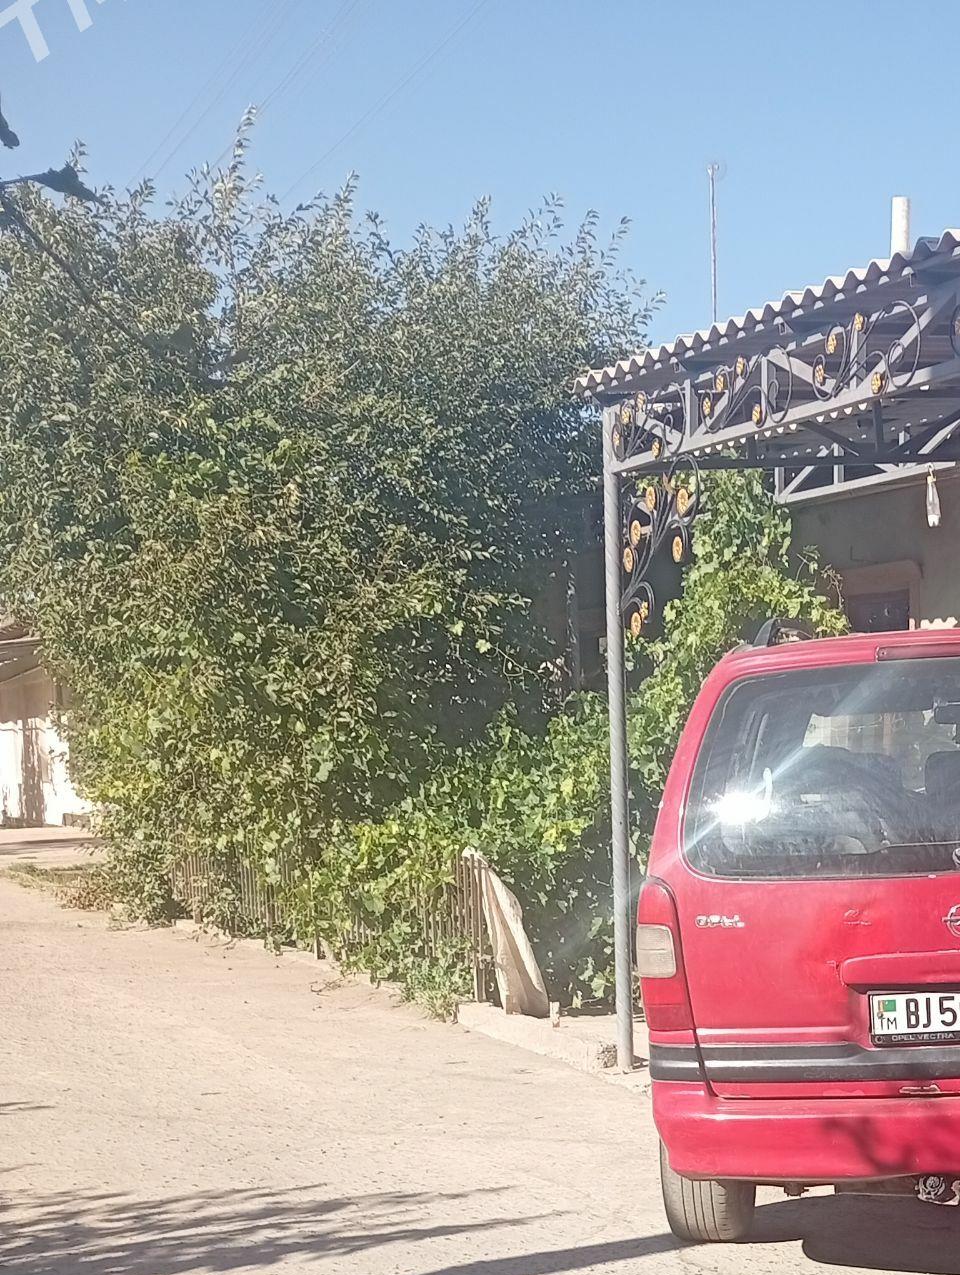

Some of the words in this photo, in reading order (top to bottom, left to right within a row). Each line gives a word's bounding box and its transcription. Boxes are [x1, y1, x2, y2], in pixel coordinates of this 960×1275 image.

[905, 997, 931, 1029] BJ
[879, 1016, 898, 1031] TM
[891, 1033, 918, 1042] OPEL
[919, 1032, 955, 1041] VECTRA
